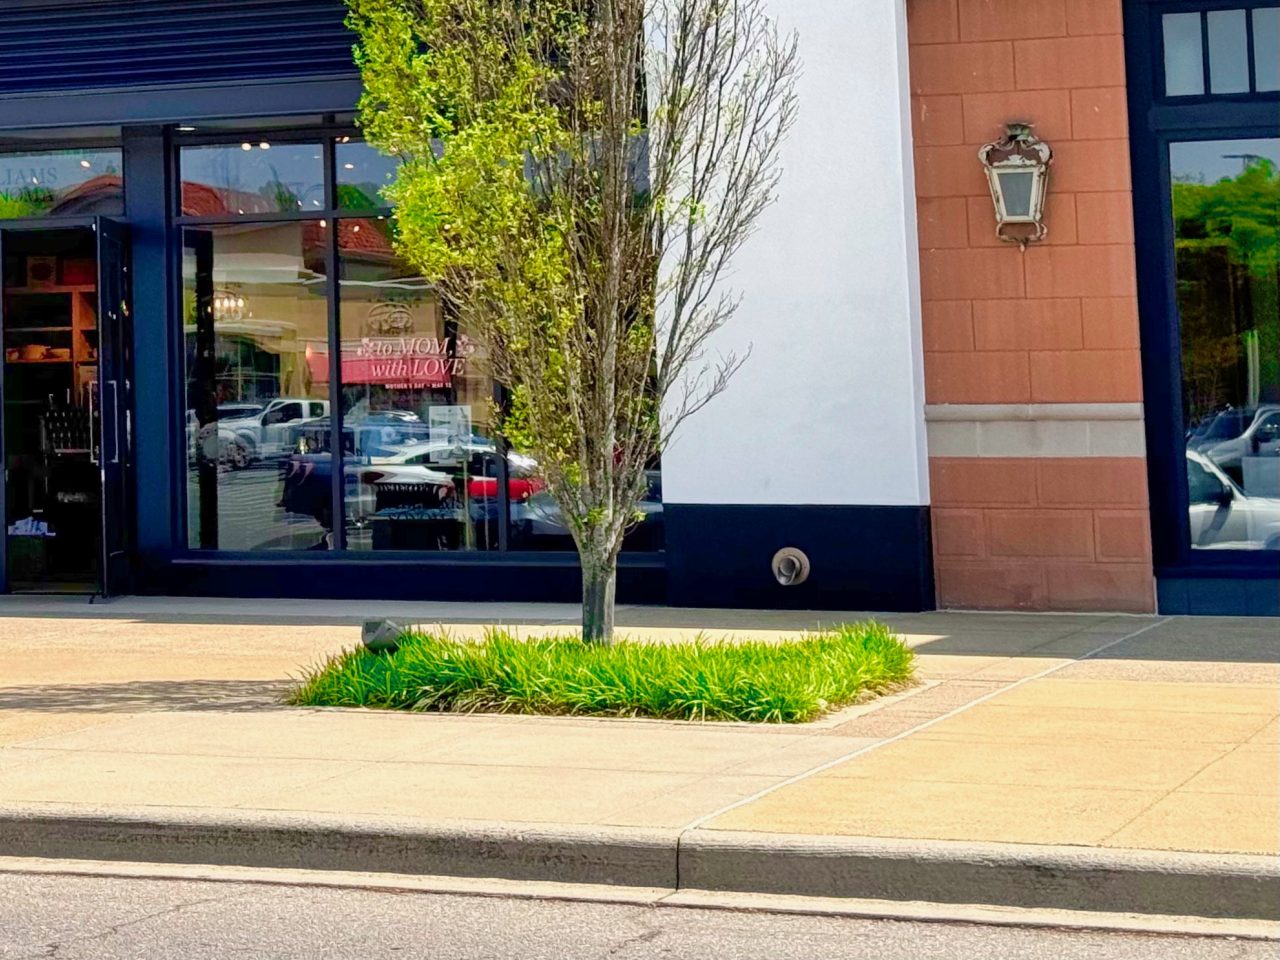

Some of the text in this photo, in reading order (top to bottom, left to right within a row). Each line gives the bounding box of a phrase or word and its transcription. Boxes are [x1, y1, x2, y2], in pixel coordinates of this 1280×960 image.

[376, 337, 453, 356] to MOM,
[371, 358, 466, 377] with LOVE
